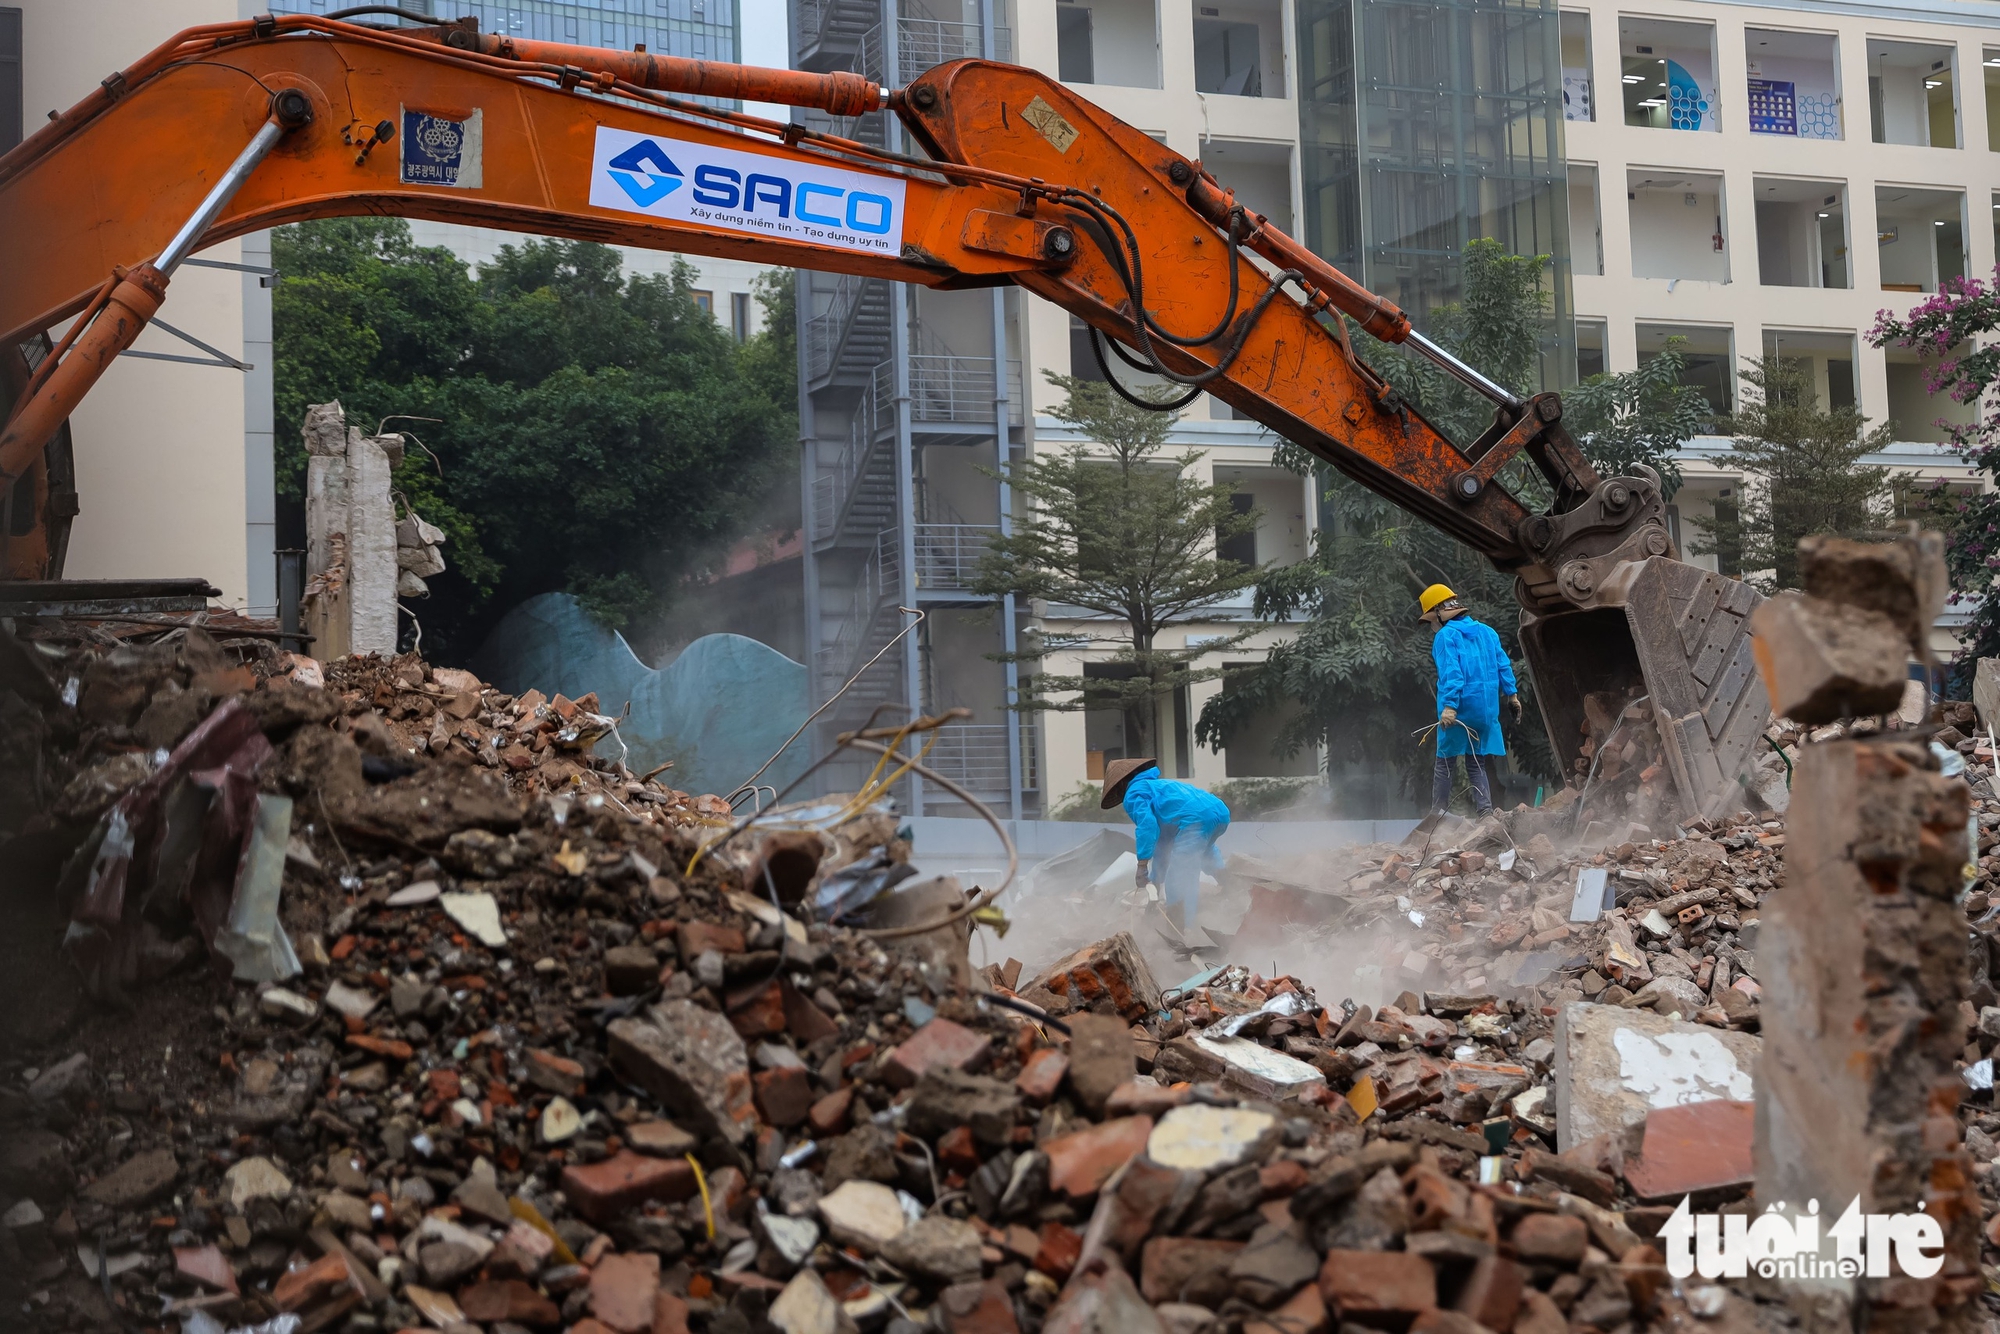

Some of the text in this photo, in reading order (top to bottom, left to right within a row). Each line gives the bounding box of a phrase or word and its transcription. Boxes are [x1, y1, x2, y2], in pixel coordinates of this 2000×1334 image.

[690, 207, 711, 219] Xây
[777, 222, 792, 232] tin
[803, 226, 824, 238] Tạo
[858, 237, 872, 246] uy
[692, 164, 892, 235] SACO
